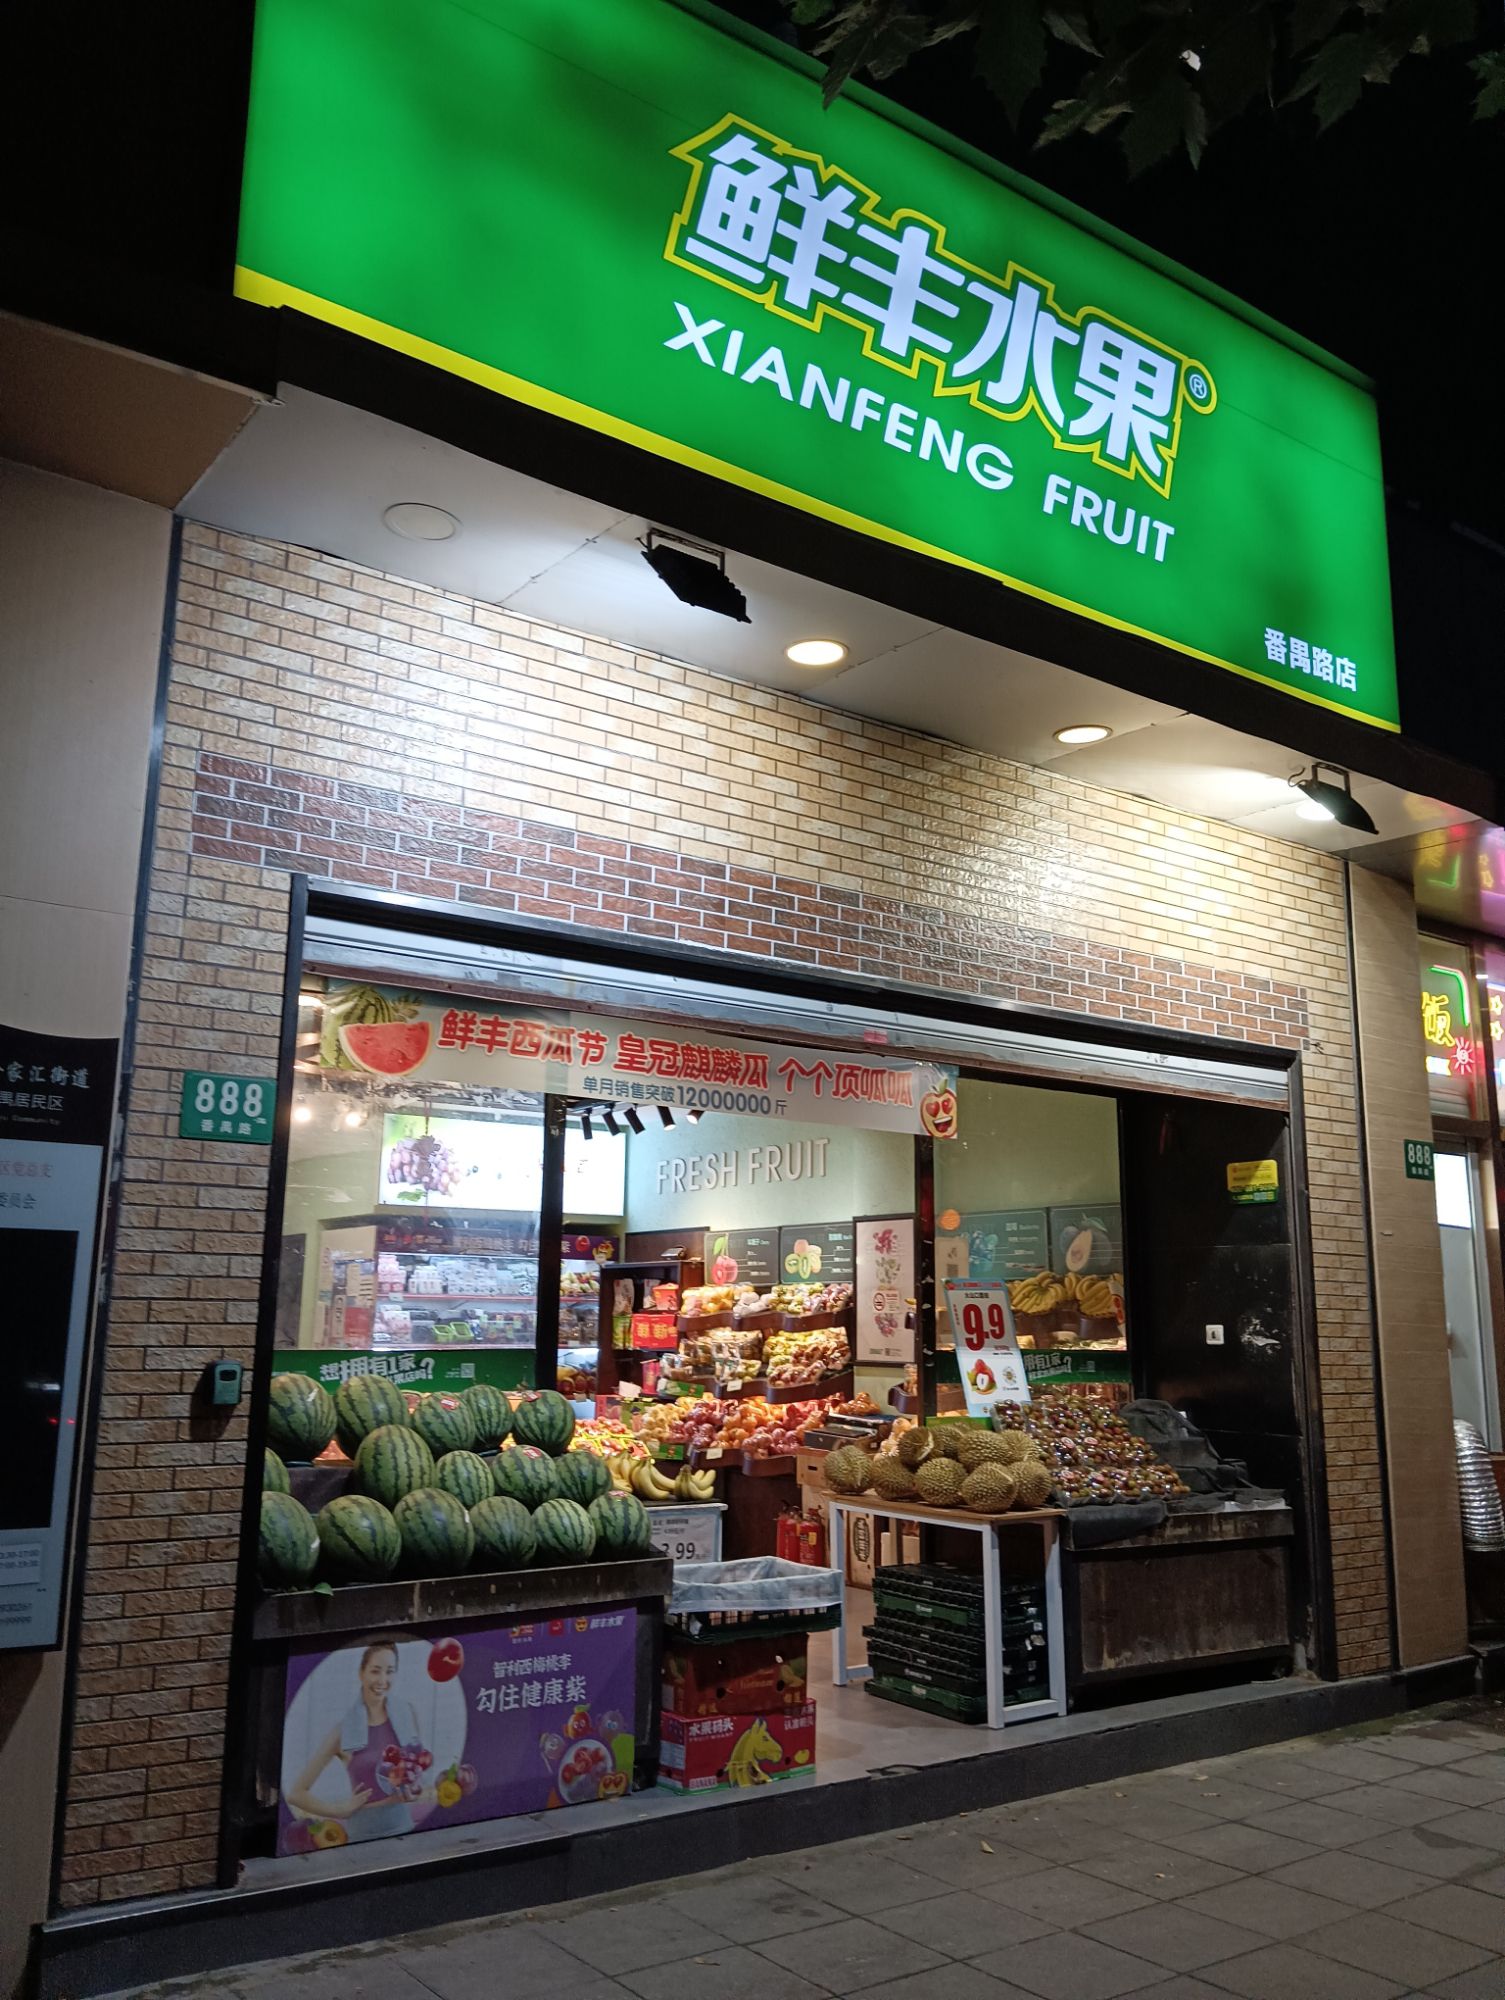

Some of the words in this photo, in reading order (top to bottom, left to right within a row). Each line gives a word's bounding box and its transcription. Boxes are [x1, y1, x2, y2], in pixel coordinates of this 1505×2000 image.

[685, 133, 1178, 477] 鲜丰水果
[664, 302, 1014, 490] XIANFENG
[1042, 474, 1175, 562] FRUIT
[1264, 627, 1357, 692] 番禺路店
[0, 1061, 90, 1089] 家汇街道
[437, 1008, 608, 1067] 鲜丰西瓜节
[613, 1033, 769, 1088] 皇冠麒麟瓜
[778, 1057, 914, 1107] 个个顶呱呱
[195, 1079, 262, 1117] 888
[656, 1150, 738, 1194] FRESH
[749, 1138, 829, 1184] FRUIT
[1407, 1143, 1431, 1165] 888
[963, 1303, 1005, 1351] 9.9
[475, 1675, 588, 1713] 勾住健康紫
